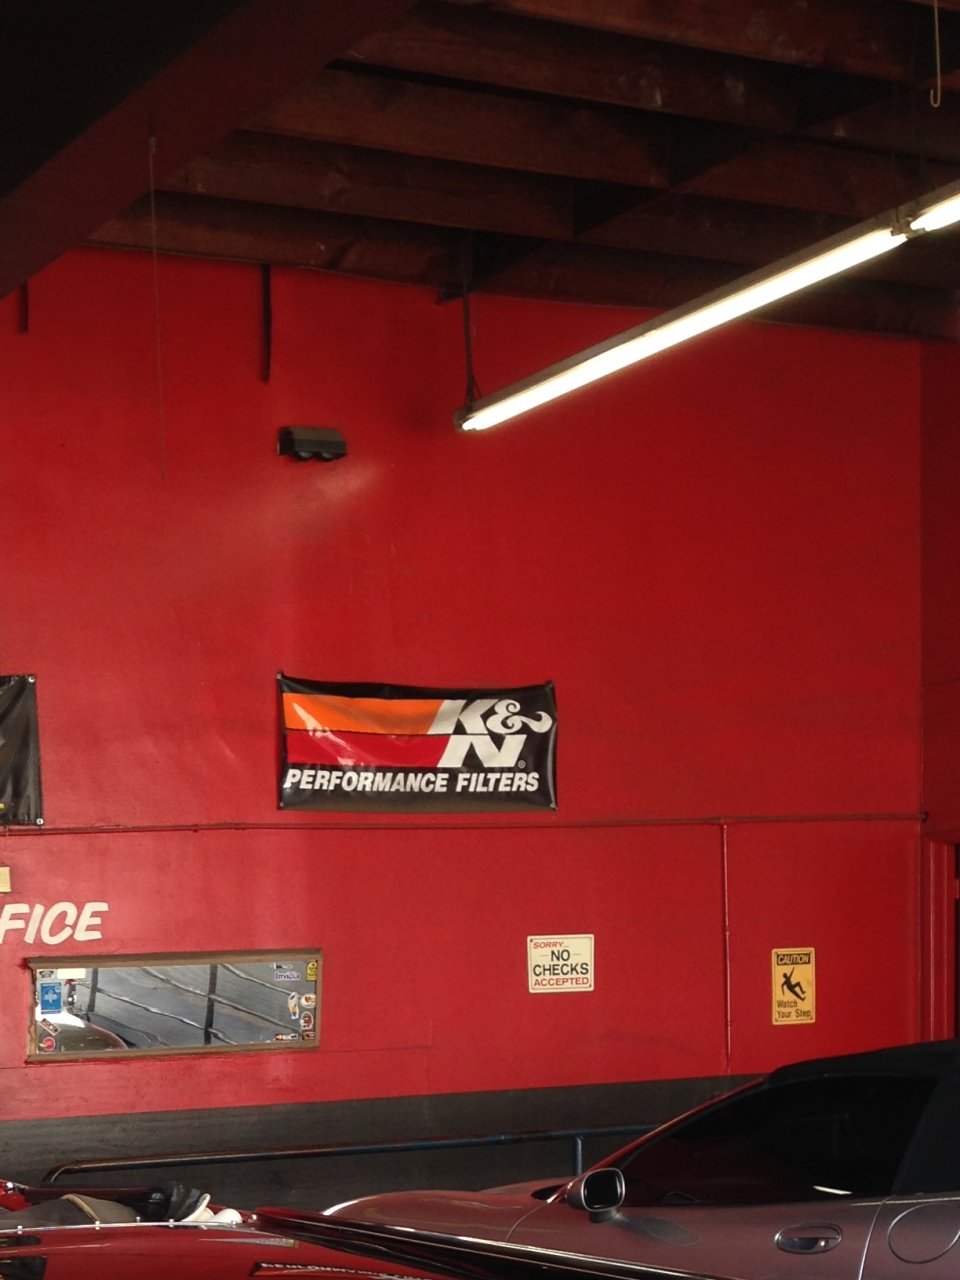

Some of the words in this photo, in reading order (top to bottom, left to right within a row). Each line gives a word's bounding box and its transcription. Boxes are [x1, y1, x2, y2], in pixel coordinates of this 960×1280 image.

[284, 769, 448, 792] PERFORMANCE
[456, 772, 540, 792] FILTERS
[551, 949, 571, 962] NO
[777, 954, 809, 965] CAUTION
[533, 962, 589, 977] CHECKS
[534, 977, 590, 987] ACCEPTED
[777, 1000, 798, 1009] Watch
[777, 1010, 792, 1019] Your
[795, 1008, 812, 1019] Step
